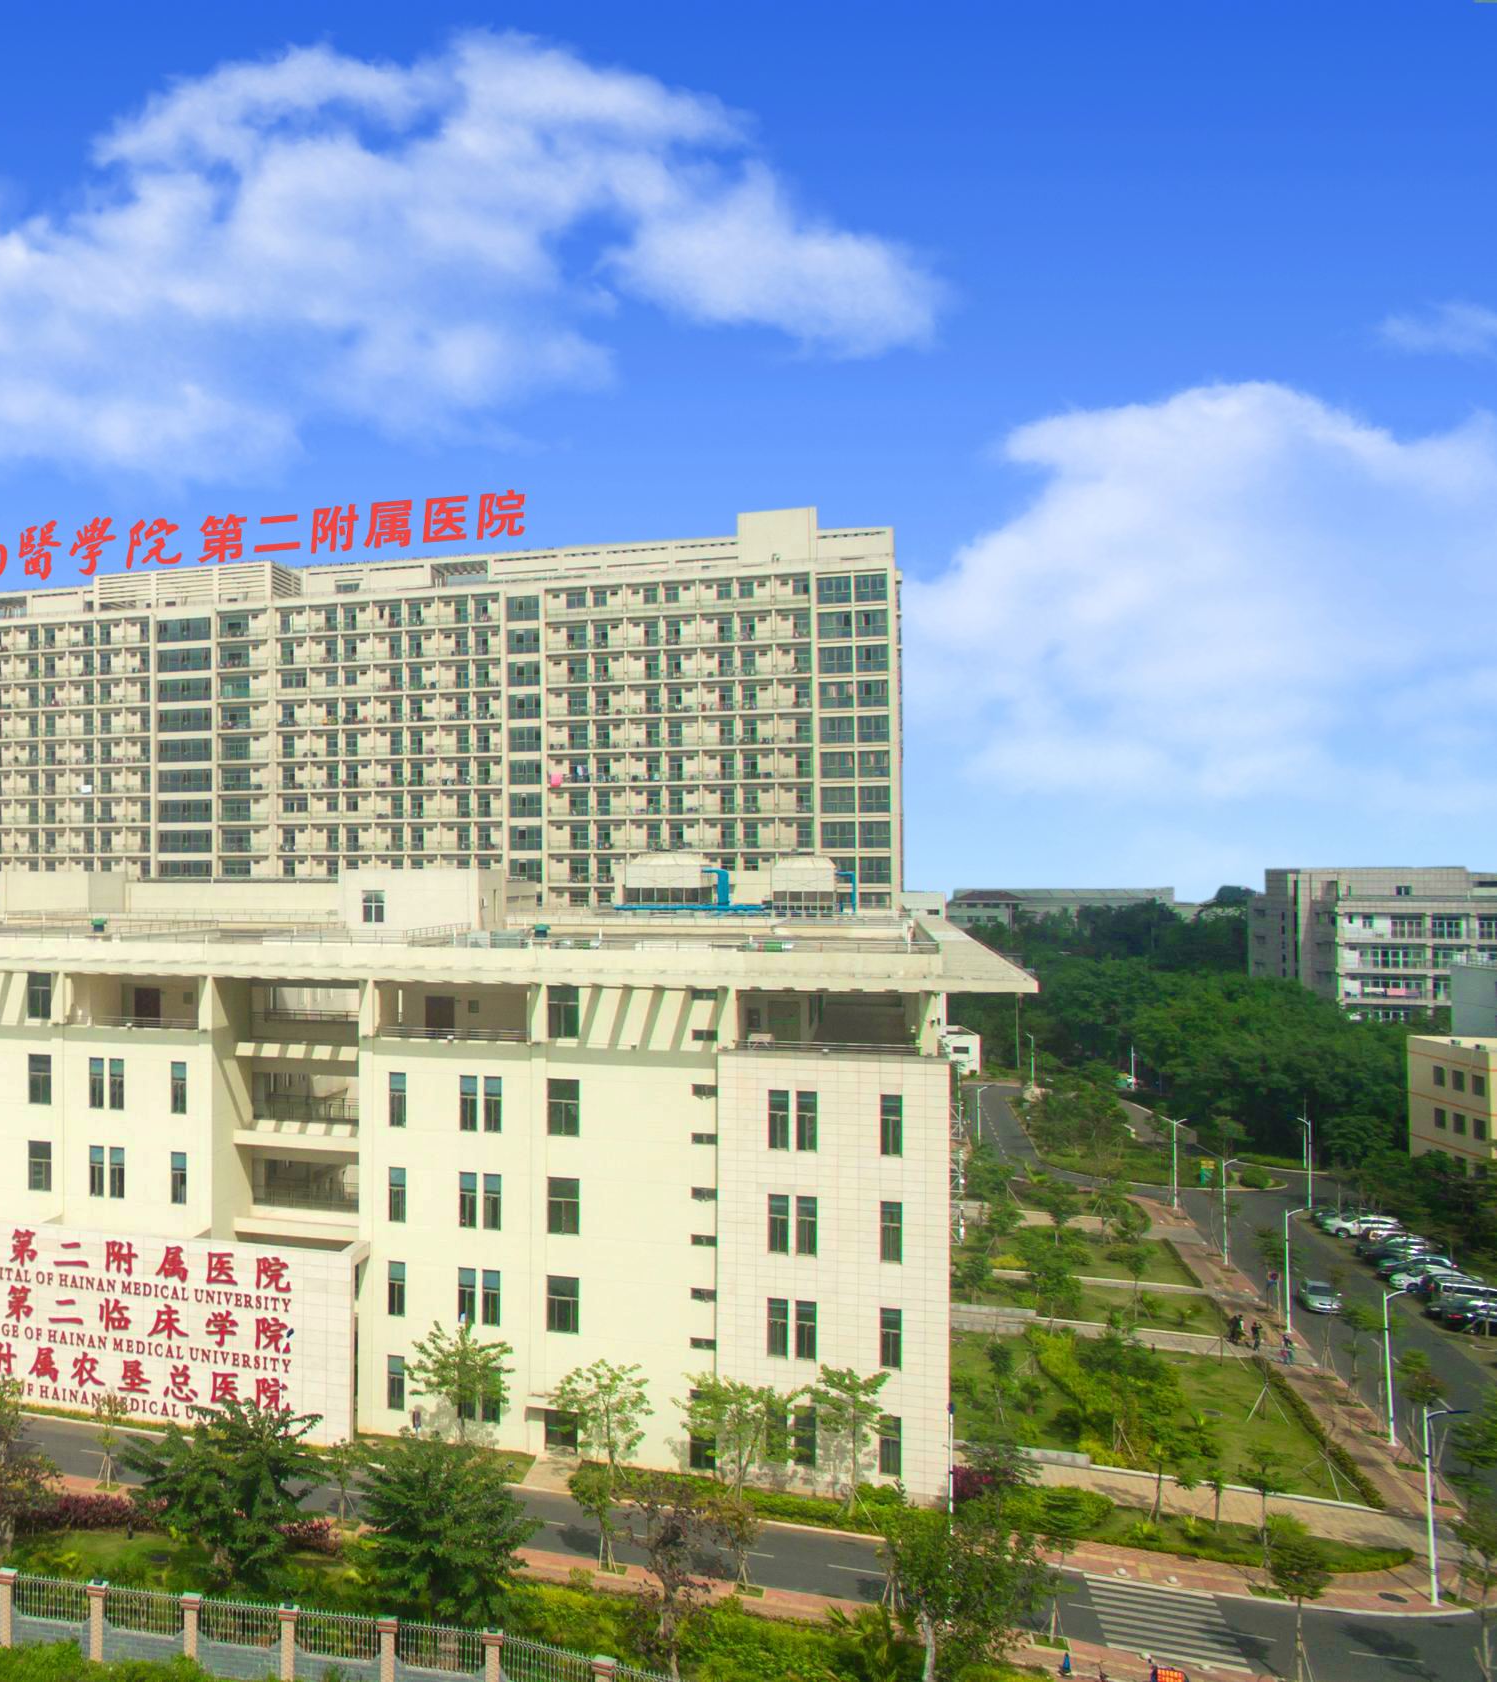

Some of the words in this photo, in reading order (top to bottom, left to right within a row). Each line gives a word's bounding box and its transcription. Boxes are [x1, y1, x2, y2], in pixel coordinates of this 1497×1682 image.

[36, 1271, 53, 1285] OF
[59, 1274, 116, 1295] HAINAN
[121, 1281, 189, 1302] MEDICAL
[194, 1289, 292, 1313] UNIVERSITY
[24, 1326, 43, 1341] OF
[48, 1331, 107, 1351] HAINAN
[113, 1338, 185, 1360] MEDICAL
[190, 1347, 292, 1374] UNIVERSITY
[106, 1395, 181, 1418] EDICAL
